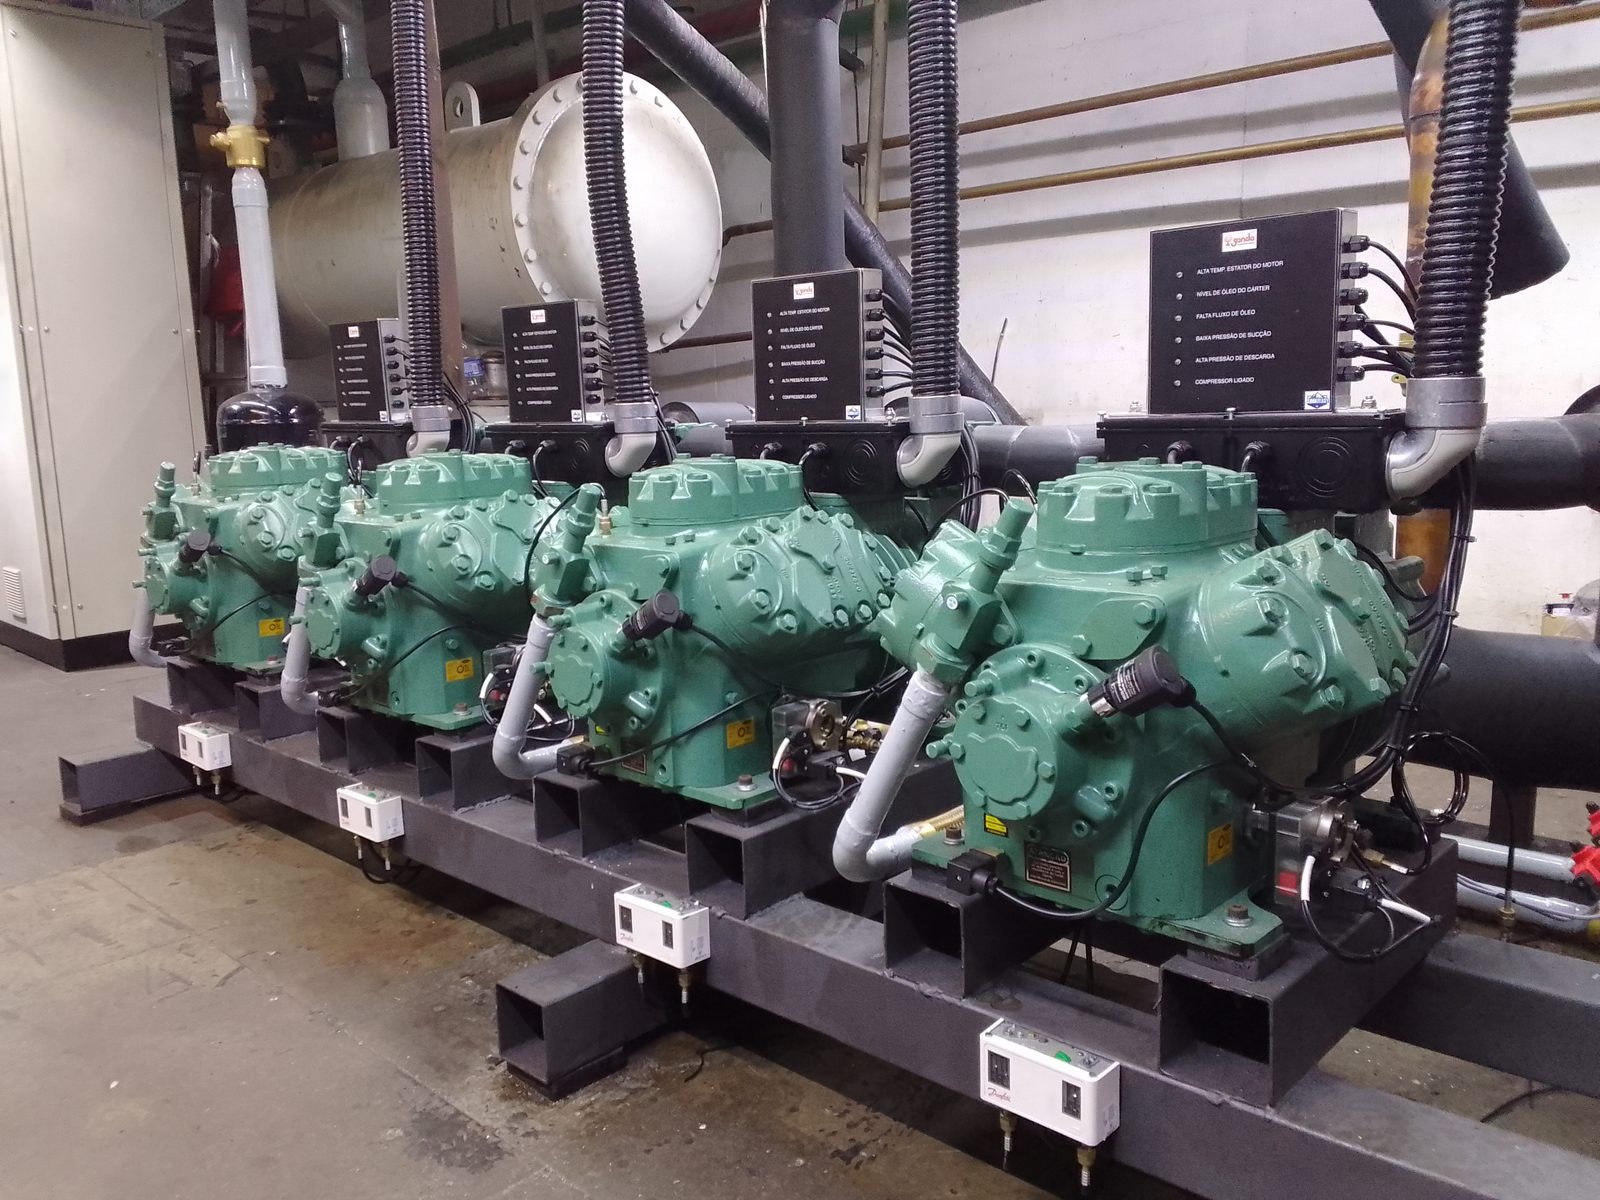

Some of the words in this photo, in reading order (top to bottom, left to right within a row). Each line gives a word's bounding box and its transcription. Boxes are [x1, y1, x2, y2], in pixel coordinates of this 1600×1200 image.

[1226, 264, 1252, 272] ESTATOR
[1221, 287, 1237, 295] ÓLEO
[1212, 332, 1238, 340] PRESSÃO
[1247, 330, 1272, 339] SUCÇÃO
[1208, 354, 1235, 362] PRESSÃO
